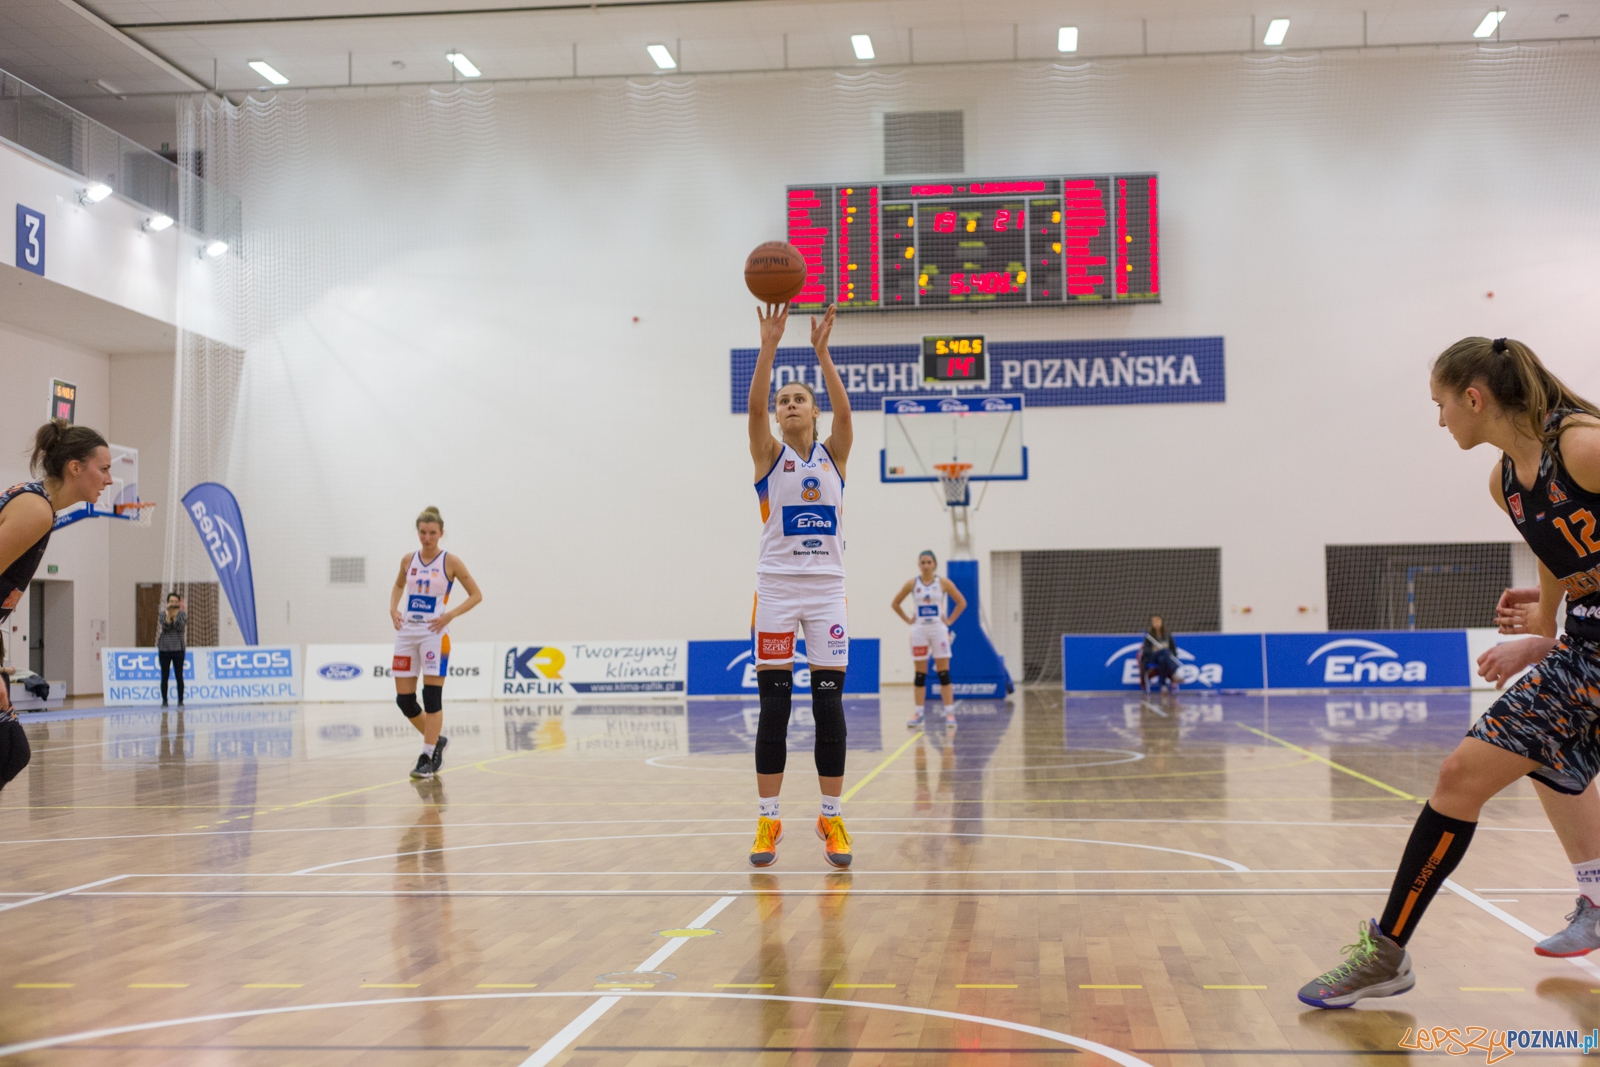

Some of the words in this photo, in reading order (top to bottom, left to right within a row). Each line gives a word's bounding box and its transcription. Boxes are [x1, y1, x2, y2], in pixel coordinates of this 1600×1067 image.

[25, 213, 40, 266] 3
[1001, 351, 1201, 389] POZNAŃSKA
[801, 476, 821, 502] 8
[191, 501, 233, 569] Enea
[797, 518, 832, 528] Enea
[1552, 508, 1600, 557] 12
[416, 579, 430, 594] 11
[572, 644, 678, 662] Tworzymy
[325, 665, 358, 679] Ford
[606, 662, 677, 678] klimat!
[1324, 655, 1427, 682] Enea
[503, 682, 564, 694] RAFLIK
[1412, 856, 1440, 893] BASKET
